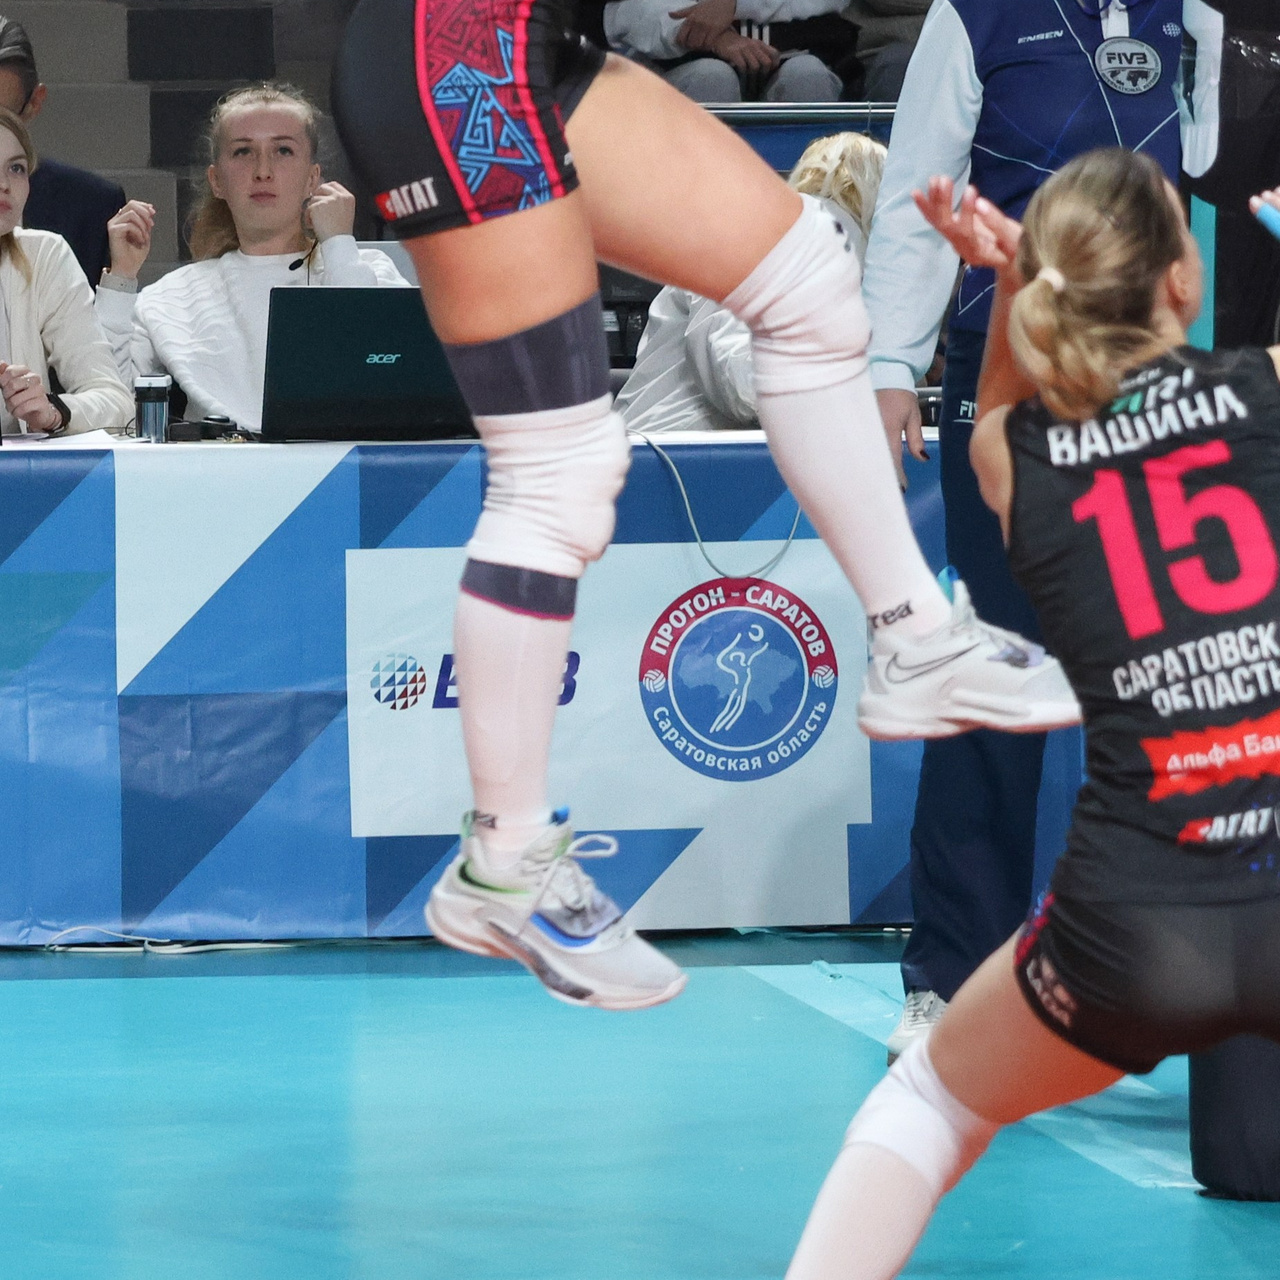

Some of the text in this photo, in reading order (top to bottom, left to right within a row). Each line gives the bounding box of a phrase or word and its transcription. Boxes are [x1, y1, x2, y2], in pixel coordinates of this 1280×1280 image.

[1106, 52, 1148, 65] FIVB
[366, 354, 402, 363] acer
[1047, 384, 1248, 467] ВАШИНА
[1071, 438, 1280, 641] 15
[650, 586, 726, 656] ПРОТОН
[745, 585, 826, 658] САРАТОВ
[653, 701, 828, 772] Саратовская область
[1166, 742, 1242, 771] Альфа
